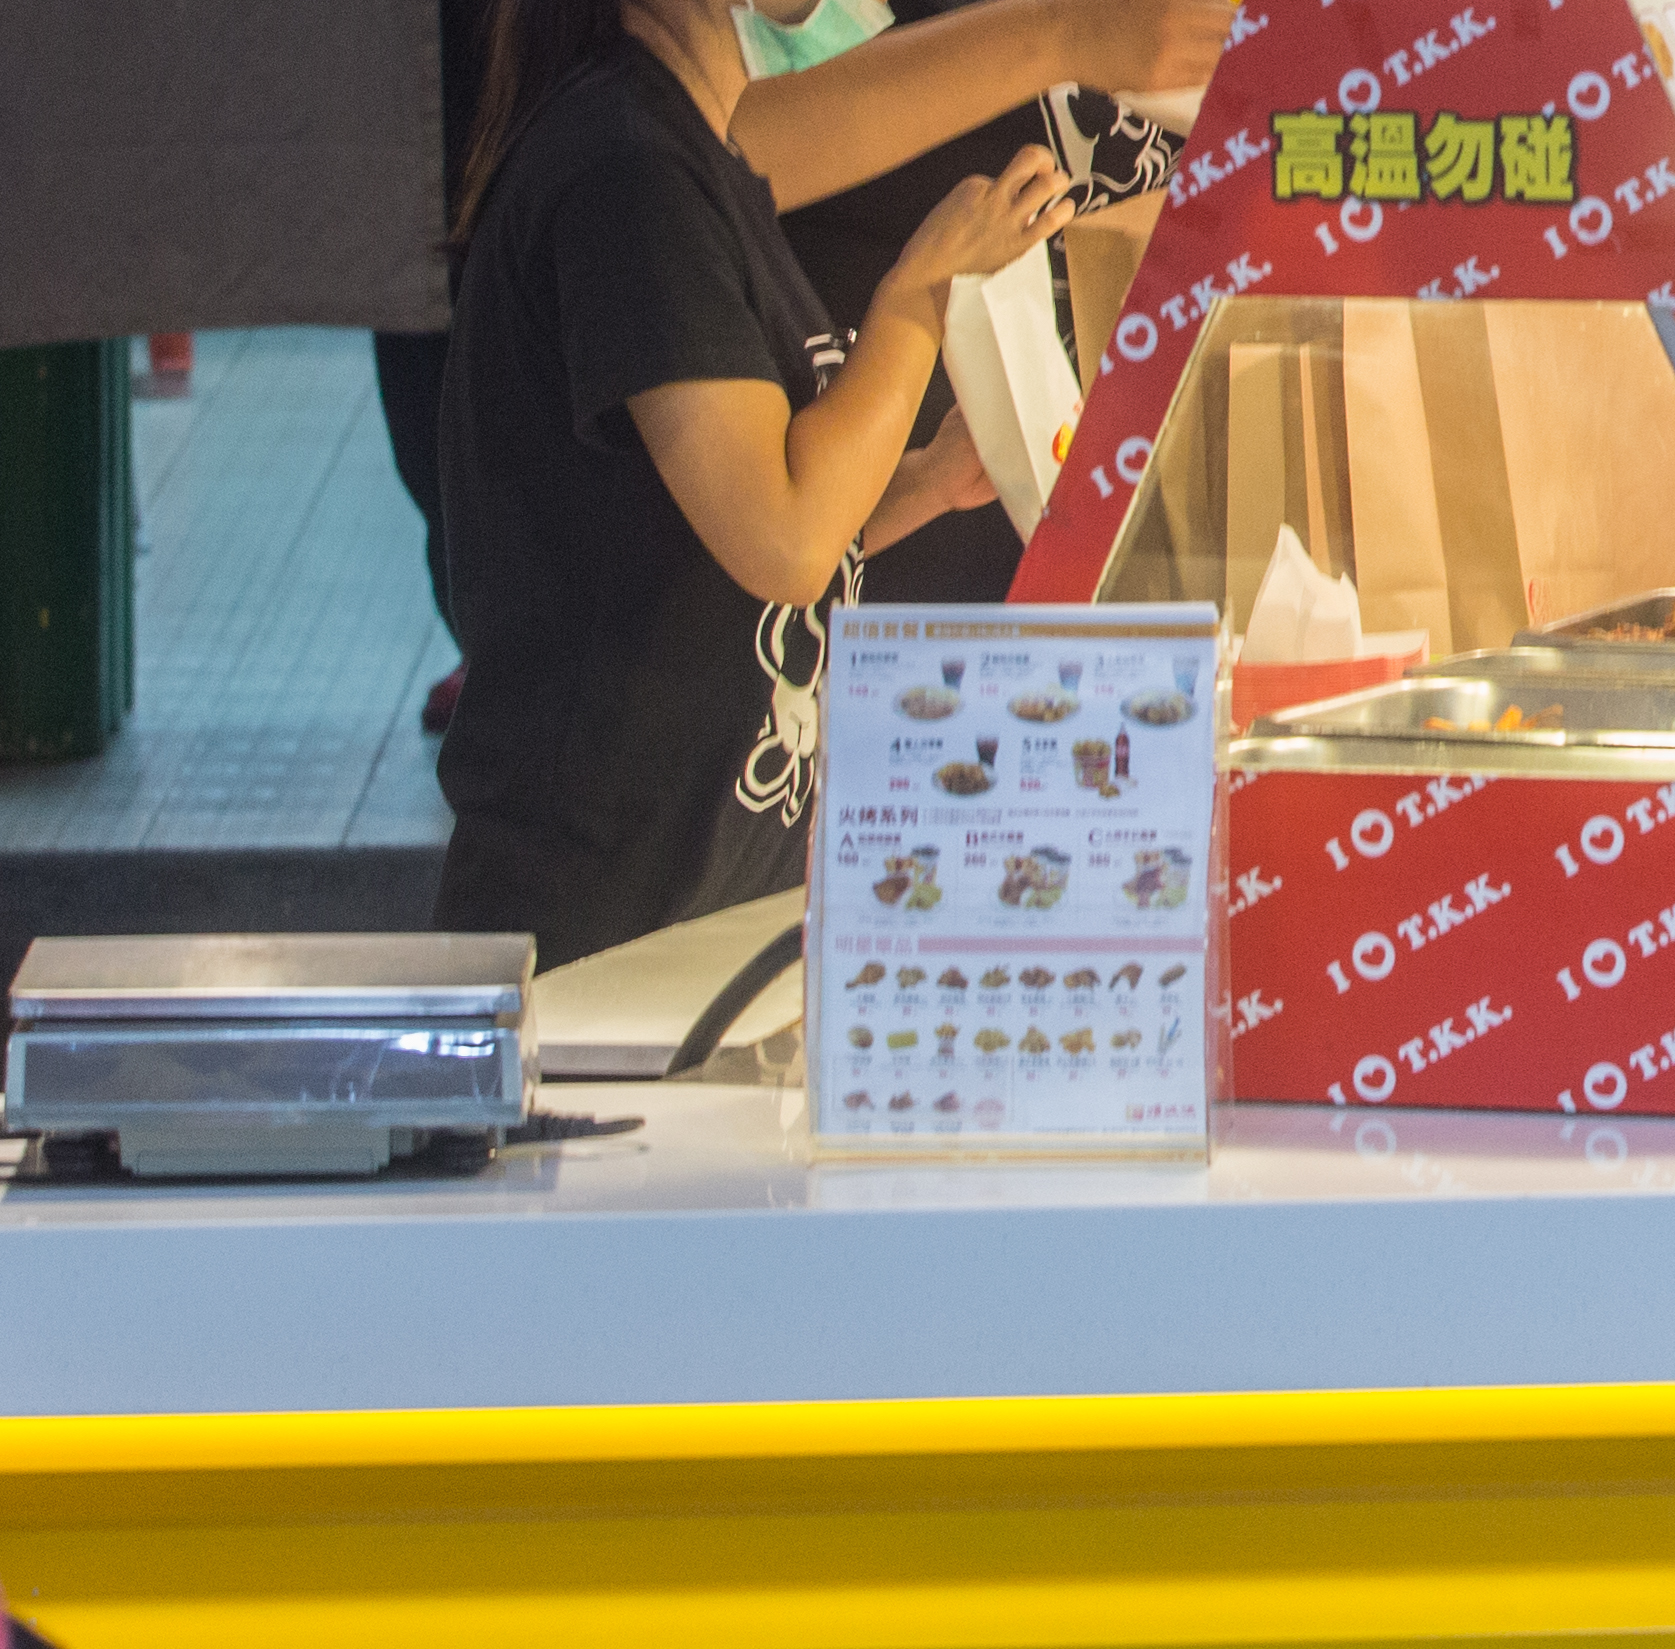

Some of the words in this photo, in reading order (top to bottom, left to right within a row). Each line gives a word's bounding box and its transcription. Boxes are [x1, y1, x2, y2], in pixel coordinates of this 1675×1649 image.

[1384, 9, 1496, 85] T.K.K.
[1273, 111, 1575, 201] 高溫勿碰
[1160, 253, 1272, 330] T.K.K.
[1325, 837, 1349, 870] I
[1555, 844, 1579, 877] I
[1327, 961, 1351, 994] I
[1397, 873, 1511, 950] T.K.K.
[1557, 967, 1581, 1000] I
[1398, 996, 1513, 1073] T.K.K.
